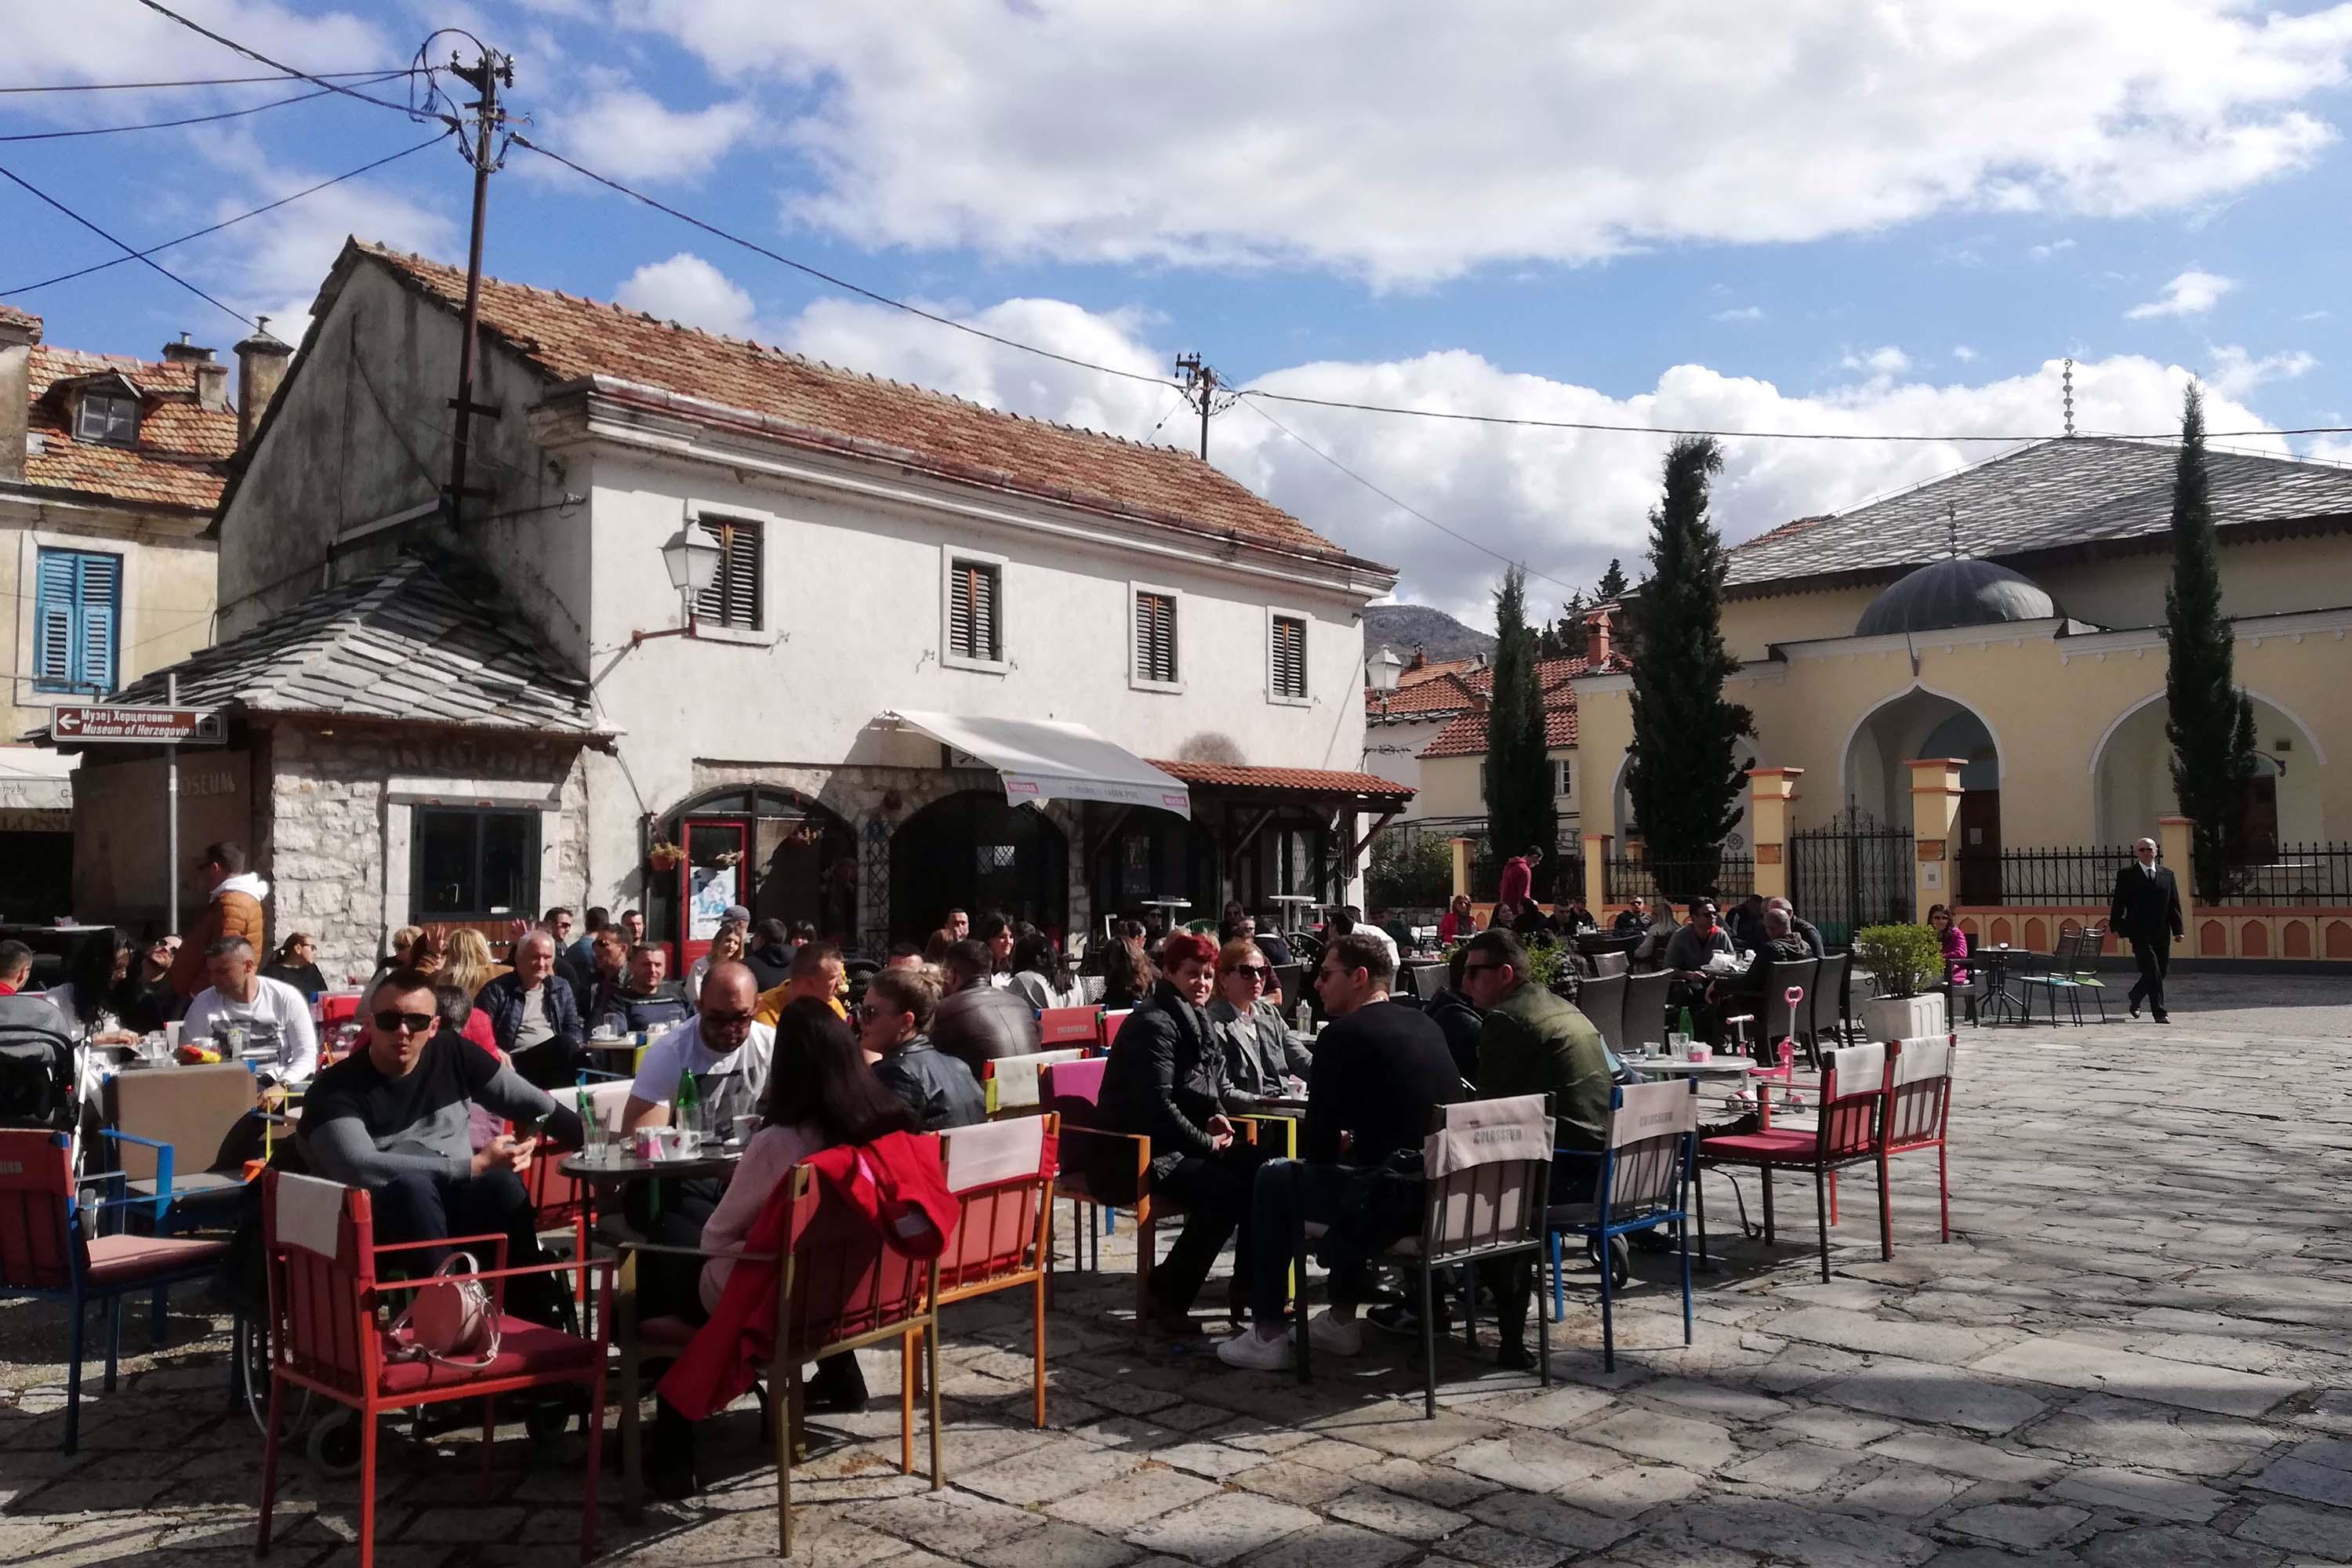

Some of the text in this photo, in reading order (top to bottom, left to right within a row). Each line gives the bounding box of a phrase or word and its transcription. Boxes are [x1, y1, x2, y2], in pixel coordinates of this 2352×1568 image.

[81, 710, 173, 724] Музеј Херцеговине
[81, 724, 122, 735] Museum
[125, 724, 134, 735] of
[1473, 1129, 1522, 1145] COLOSSEUM
